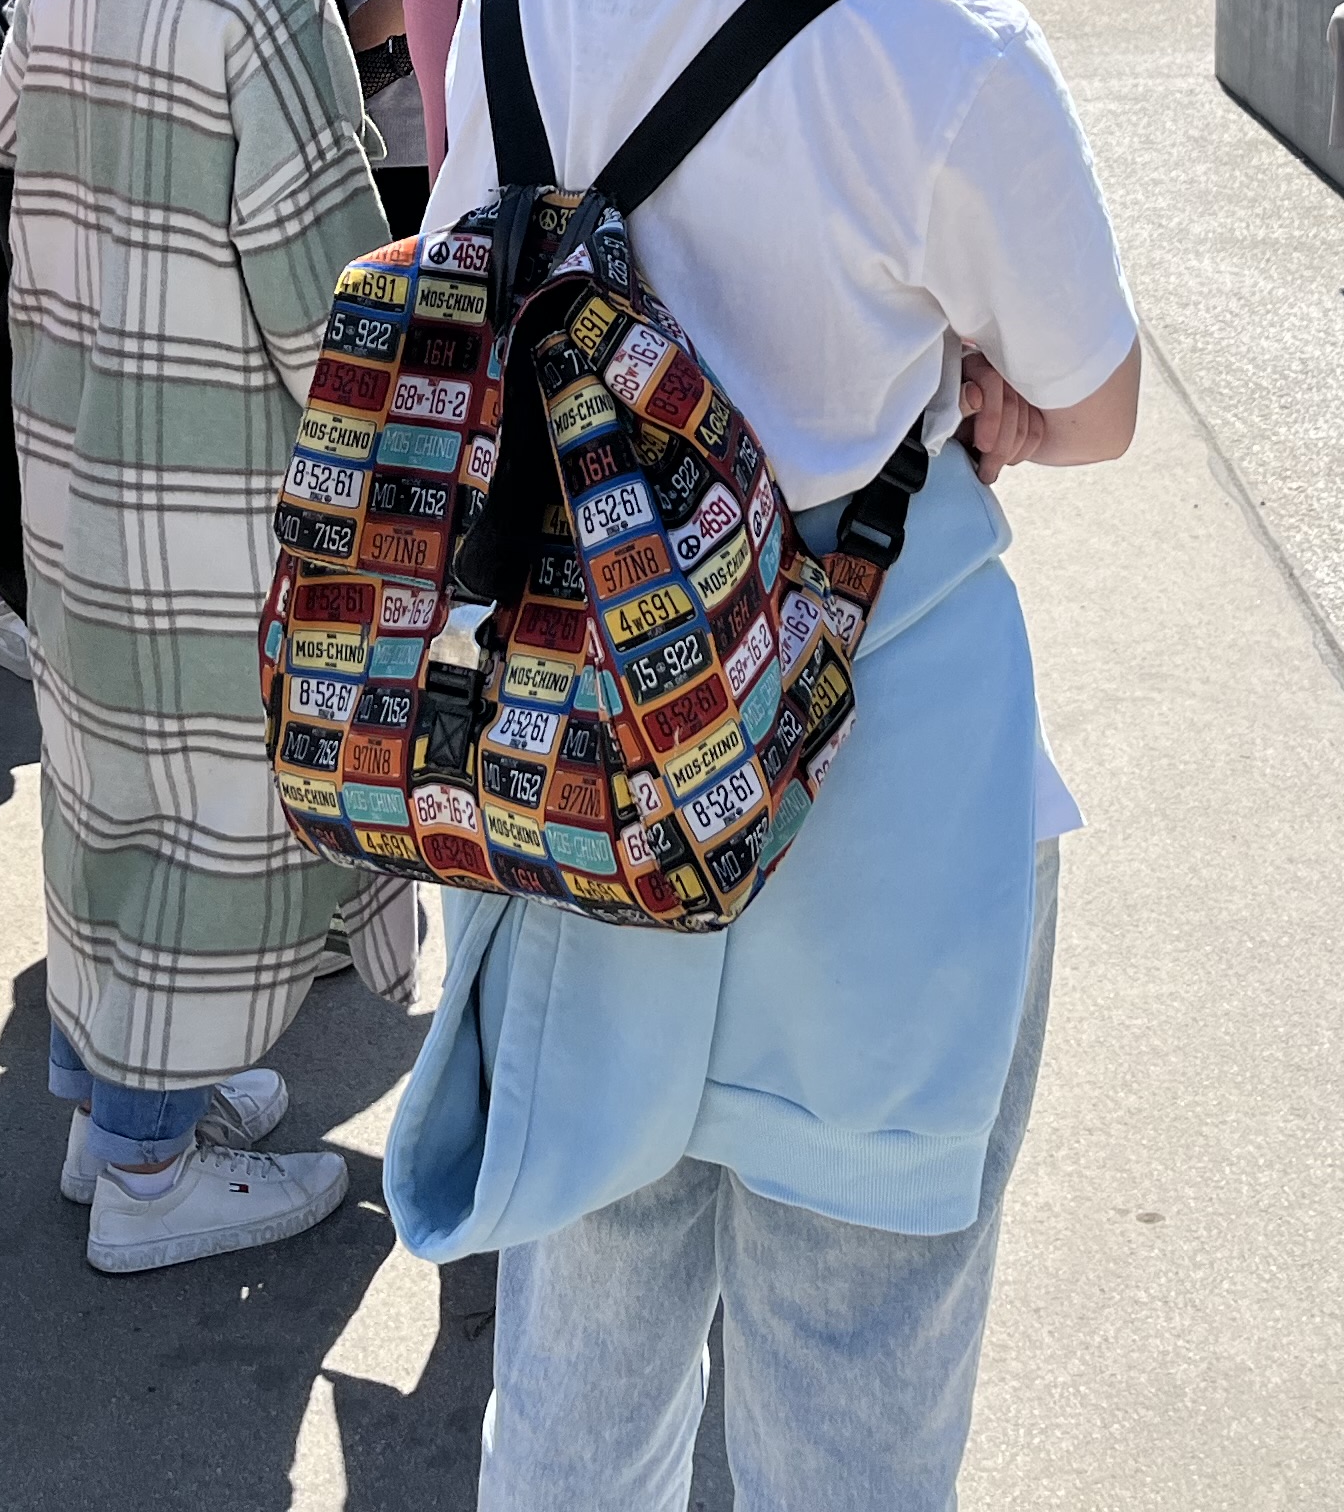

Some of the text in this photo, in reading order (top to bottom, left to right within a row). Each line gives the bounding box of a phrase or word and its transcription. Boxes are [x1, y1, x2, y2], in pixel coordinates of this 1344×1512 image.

[418, 289, 486, 316] MOS-CHINO
[294, 460, 354, 498] 8-52-61
[583, 486, 643, 534] 8-52-61
[699, 495, 737, 540] 4691
[295, 640, 366, 665] MOS-CHINO
[507, 666, 569, 694] MOS-CHINO
[671, 730, 740, 789] MOS-CHINO
[282, 782, 337, 809] MOS-CHINO
[692, 768, 755, 828] 8-52-61
[488, 814, 541, 848] MOS-CHINO
